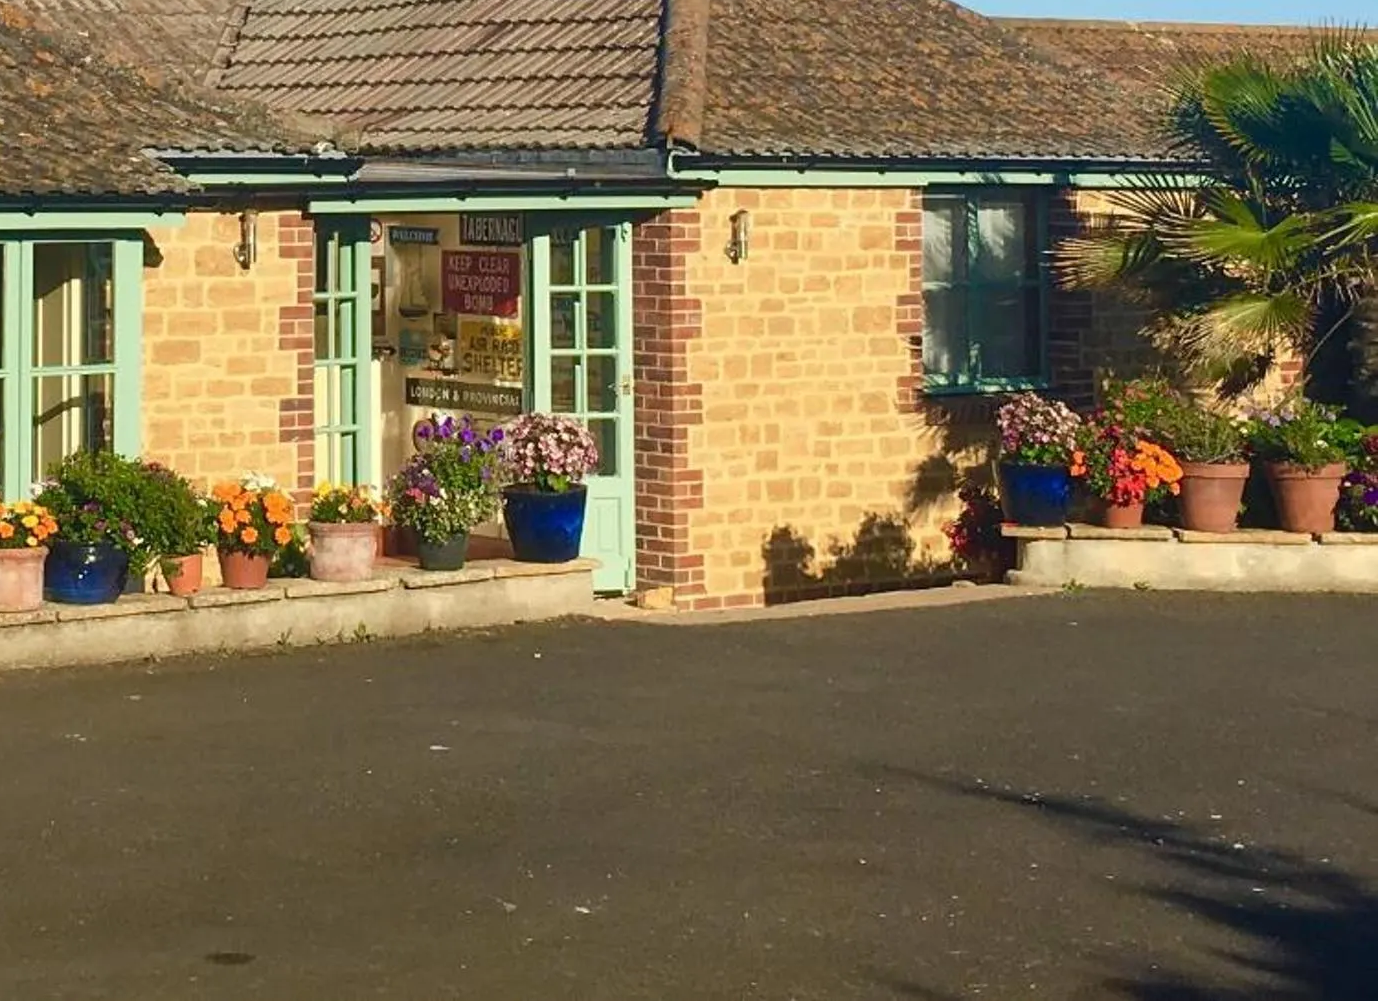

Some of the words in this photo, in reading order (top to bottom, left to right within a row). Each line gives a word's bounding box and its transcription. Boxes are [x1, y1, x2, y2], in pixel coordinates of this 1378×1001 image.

[449, 256, 472, 271] KEEP
[479, 257, 510, 275] CLEAR
[448, 274, 510, 293] UNEXPLODED
[464, 294, 494, 311] BOMB
[410, 386, 450, 401] LONDON
[453, 390, 460, 402] &
[463, 390, 519, 406] PROVINCIAL
